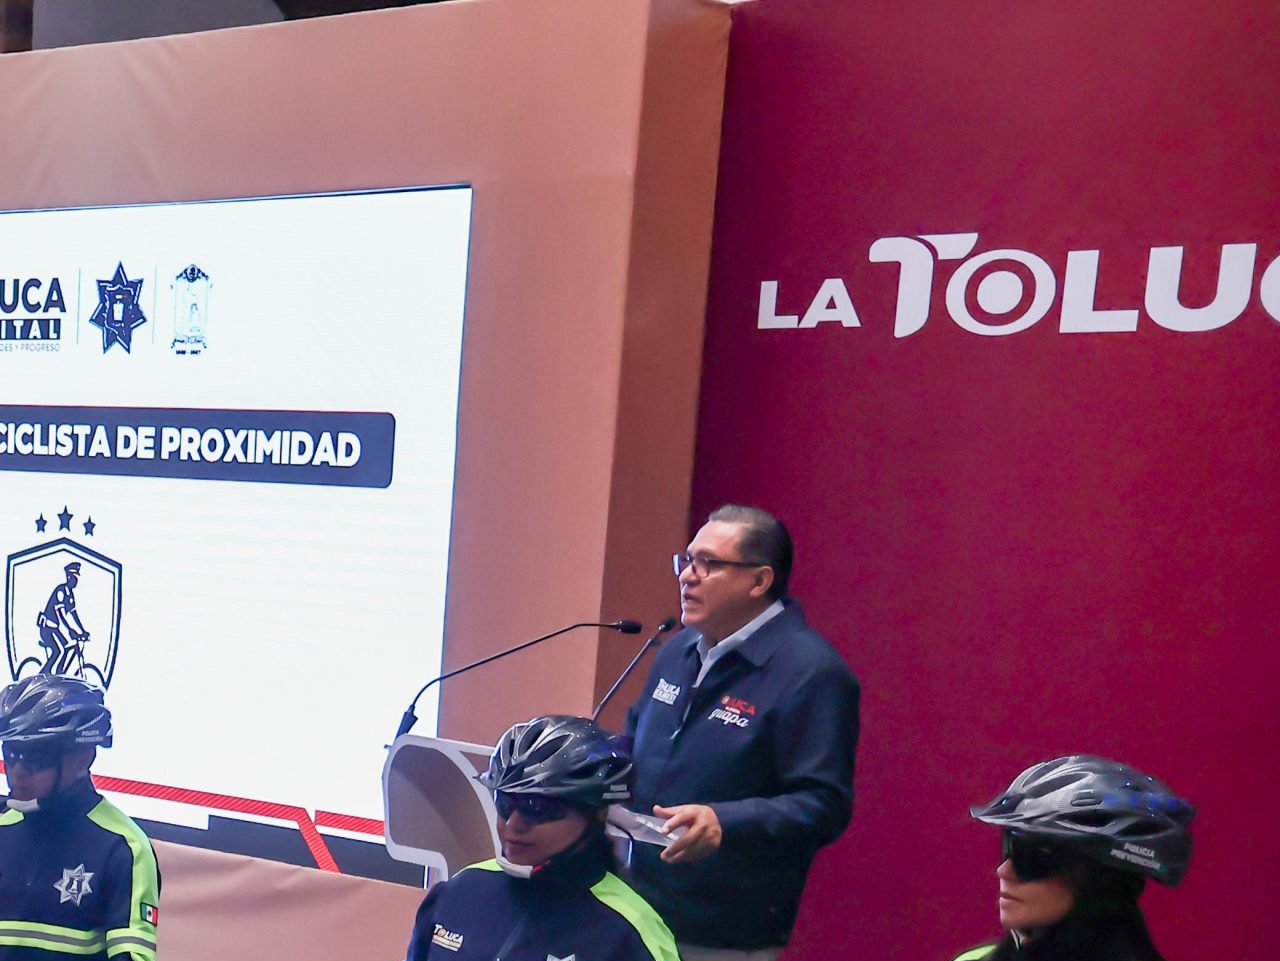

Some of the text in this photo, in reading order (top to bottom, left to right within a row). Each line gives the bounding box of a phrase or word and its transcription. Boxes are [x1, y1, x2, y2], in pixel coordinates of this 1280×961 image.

[757, 232, 1280, 338] LA TOLU
[21, 343, 61, 352] PROGRESO
[116, 425, 155, 459] DE
[161, 427, 362, 468] PROXIMIDAD
[708, 708, 749, 728] guapa
[434, 923, 464, 944] TOLUCA
